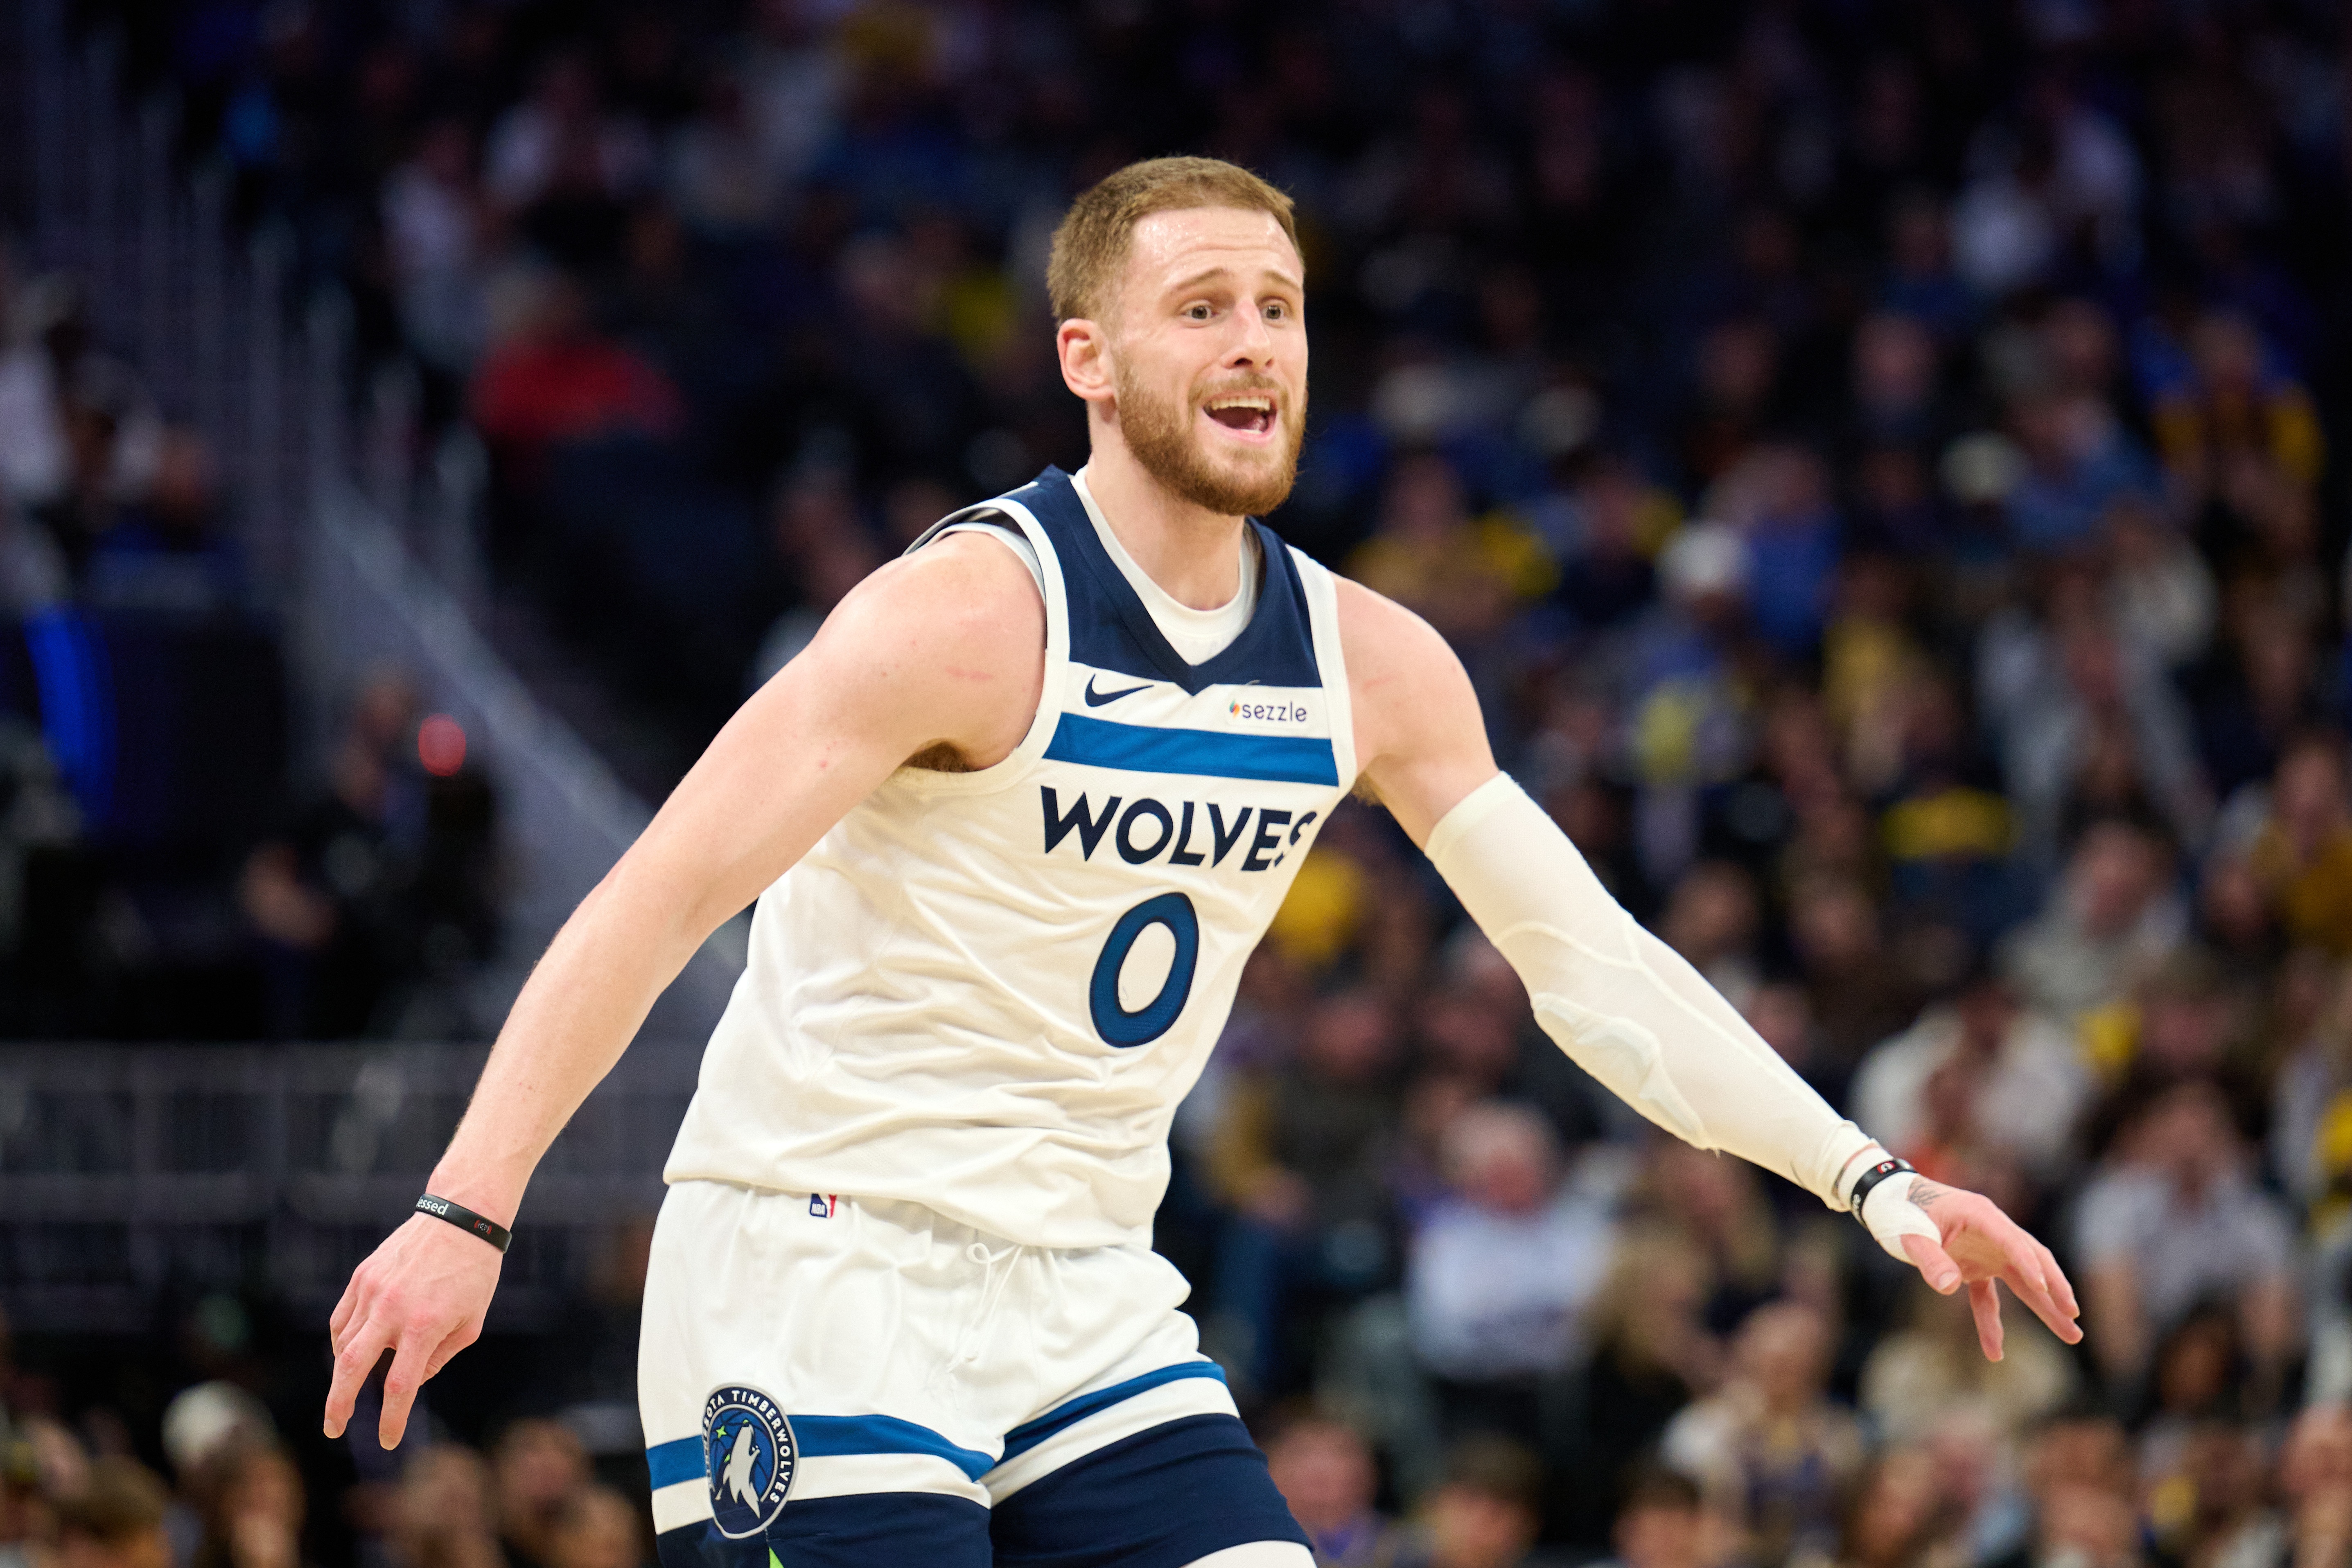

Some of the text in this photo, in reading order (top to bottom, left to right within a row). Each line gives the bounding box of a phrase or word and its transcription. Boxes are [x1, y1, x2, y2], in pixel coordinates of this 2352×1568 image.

[1242, 701, 1307, 722] sezzle
[1041, 786, 1318, 872] WOLVES
[1089, 891, 1199, 1048] 0
[811, 1203, 826, 1216] NBA
[731, 1390, 791, 1503] TIMBERWOLVES
